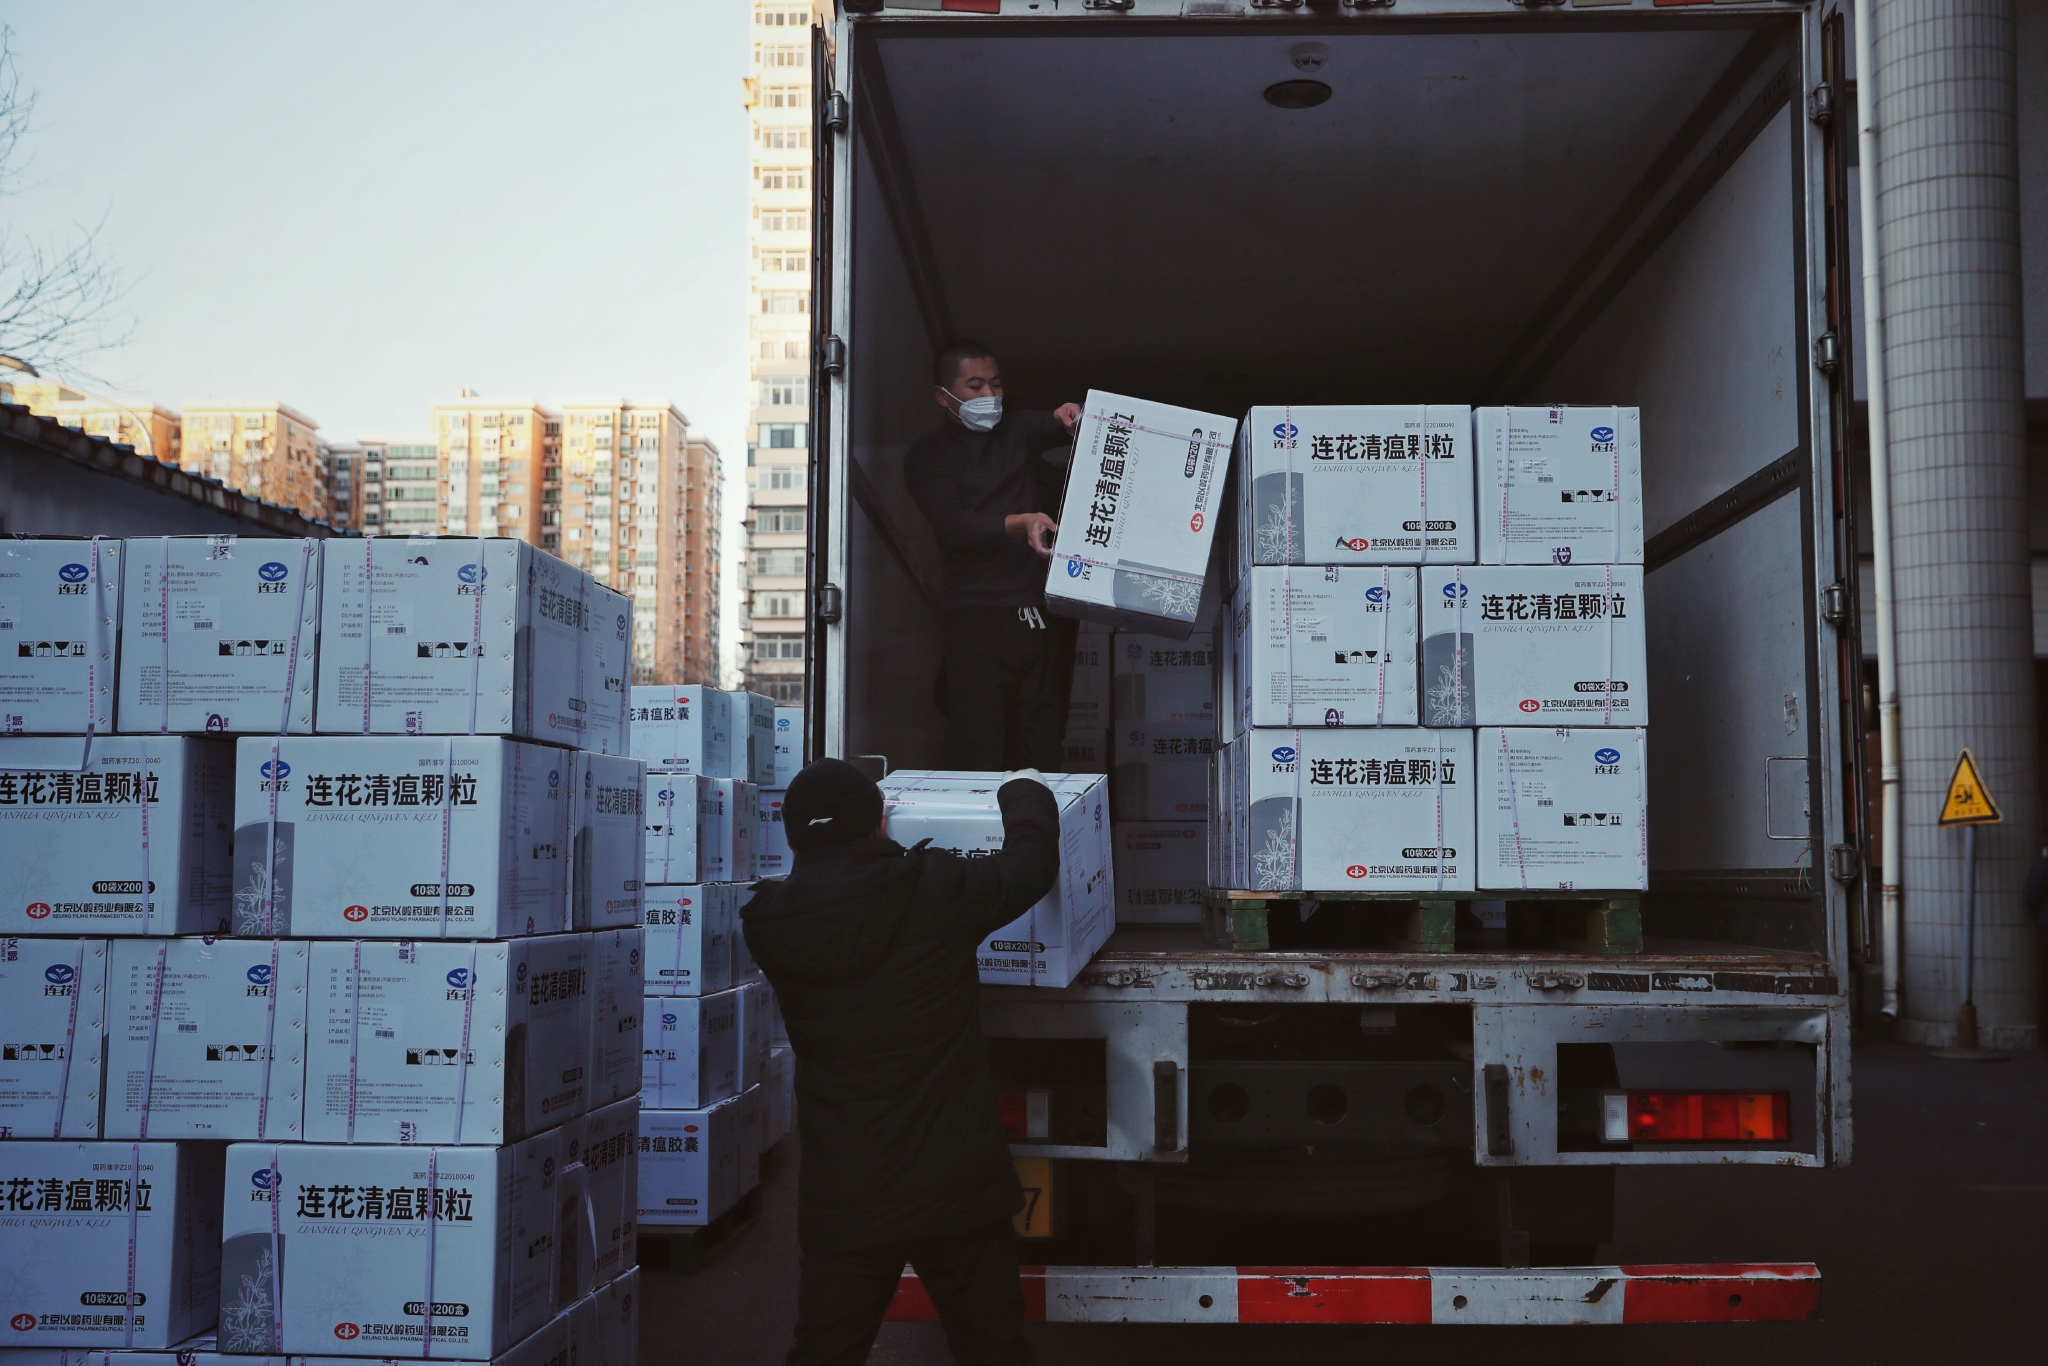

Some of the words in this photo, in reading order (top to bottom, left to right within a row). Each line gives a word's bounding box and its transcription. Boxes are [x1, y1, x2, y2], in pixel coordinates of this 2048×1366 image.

[1312, 465, 1353, 473] LIANHUA
[1356, 465, 1401, 474] QINGWEN
[1401, 465, 1421, 473] KEL
[1085, 412, 1135, 548] 连花清瘟颗粒
[1526, 625, 1571, 635] QINGWEN
[1572, 625, 1594, 633] KELI
[1577, 682, 1625, 691] 10袋X20盒
[1310, 758, 1456, 786] 连花清瘟颗粒
[305, 773, 478, 807] 连花清瘟颗粒
[1356, 790, 1401, 800] QINGWEN
[1400, 790, 1423, 799] KELI
[596, 785, 643, 816] 连花清瘟颗粒
[42, 811, 94, 823] QINGWEN
[96, 811, 121, 820] KELI
[305, 813, 355, 822] LIANHUA
[358, 813, 412, 824] QINGWEN
[412, 813, 439, 823] KELI
[1404, 848, 1453, 858] 10袋X20盒
[96, 882, 151, 893] 10袋X200
[414, 885, 471, 896] 10袋X00盒
[638, 1136, 699, 1153] 清瘟胶囊
[413, 1171, 475, 1180] 国药字Z20100040
[0, 1178, 152, 1213] 花清瘟颗粒
[296, 1184, 473, 1222] 连花清瘟颗粒
[30, 1218, 84, 1230] QINGWEN
[86, 1218, 112, 1229] KELI
[297, 1226, 347, 1235] LIANHUA
[351, 1226, 406, 1238] QINGWEN
[406, 1228, 427, 1238] KEL
[84, 1294, 142, 1305] 10袋X20盒
